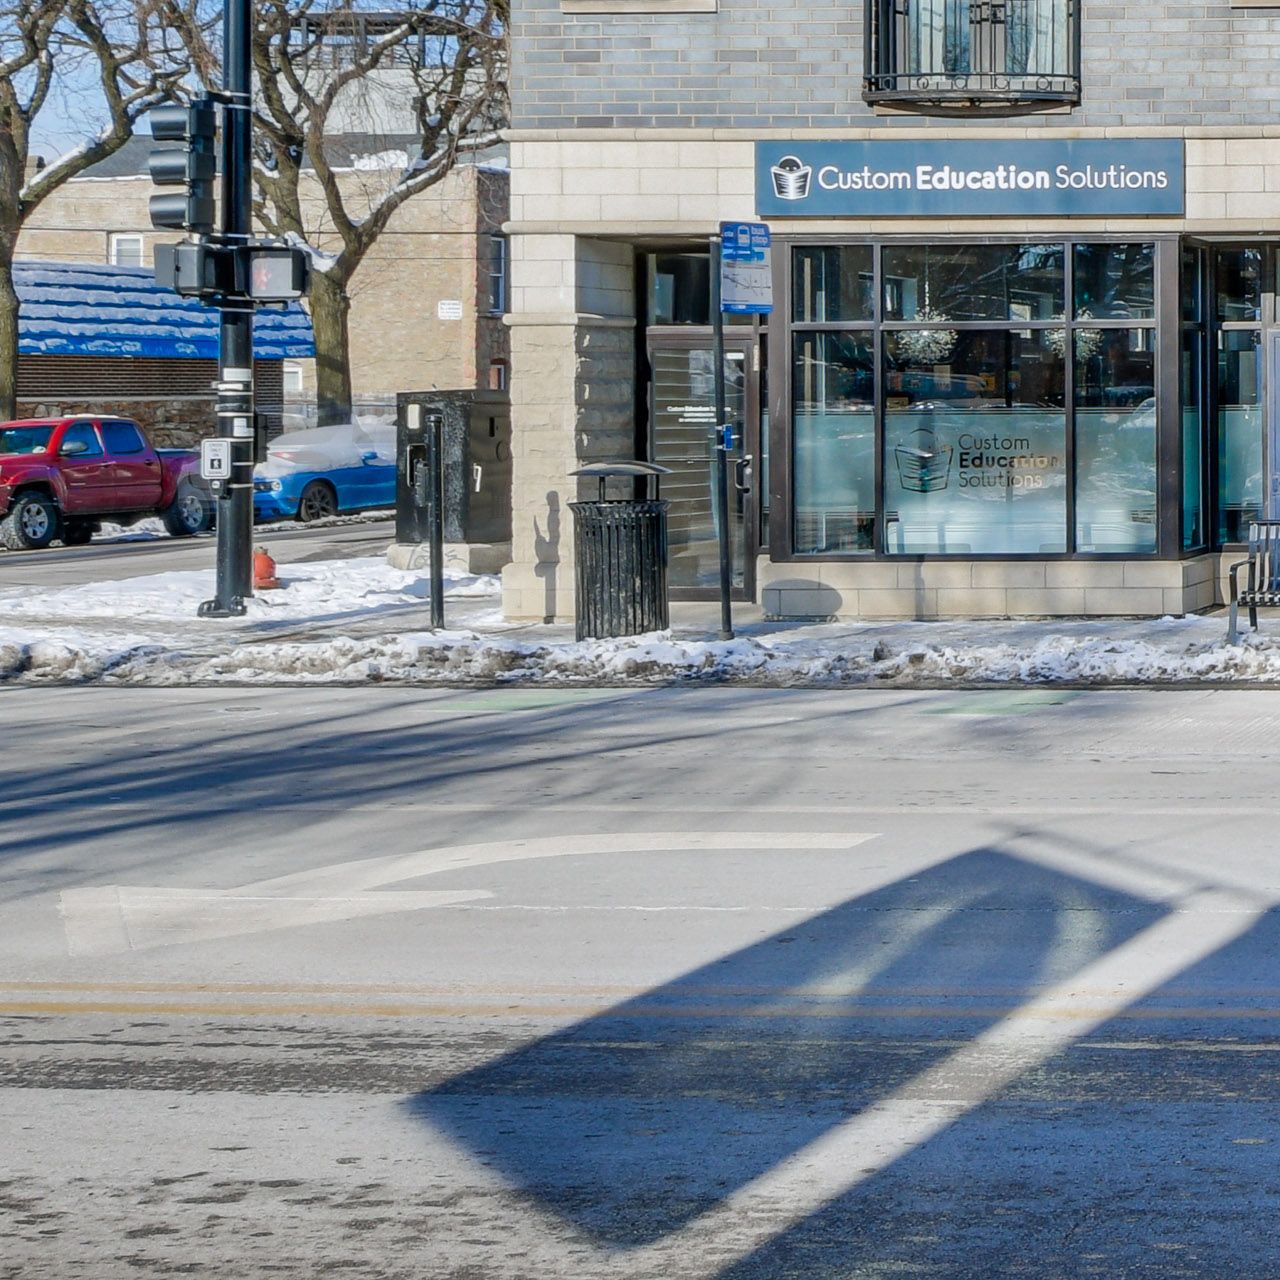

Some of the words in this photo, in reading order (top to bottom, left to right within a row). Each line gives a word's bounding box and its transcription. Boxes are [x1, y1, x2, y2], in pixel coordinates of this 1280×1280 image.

[818, 166, 911, 189] Custom
[916, 165, 1050, 190] Education
[1055, 165, 1168, 189] Solutions
[751, 236, 768, 246] stop
[958, 433, 1030, 450] Custom
[959, 452, 1059, 469] Education
[958, 471, 1043, 488] Solutions
